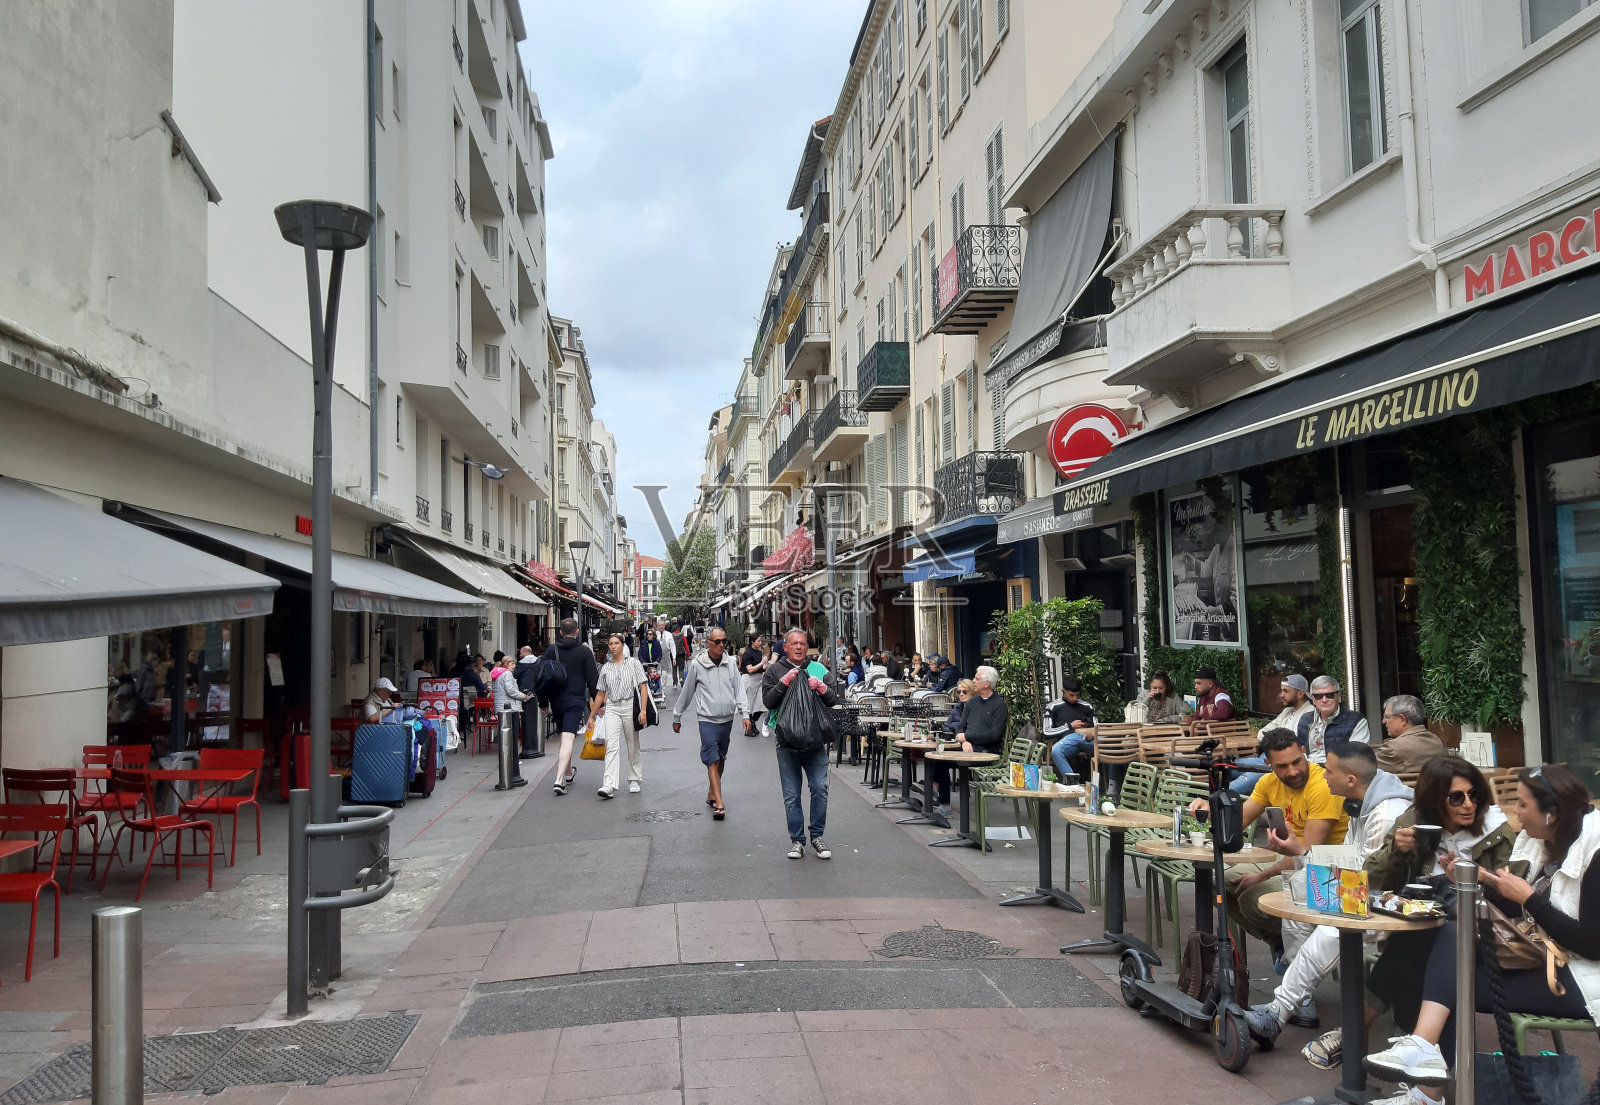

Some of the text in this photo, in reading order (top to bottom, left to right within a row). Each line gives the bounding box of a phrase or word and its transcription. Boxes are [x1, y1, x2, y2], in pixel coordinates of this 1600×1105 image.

[1464, 208, 1600, 303] MARC
[1296, 368, 1479, 449] LE MARCELLINO
[1063, 479, 1110, 512] BRASSERIE
[1207, 612, 1236, 623] Artisanale
